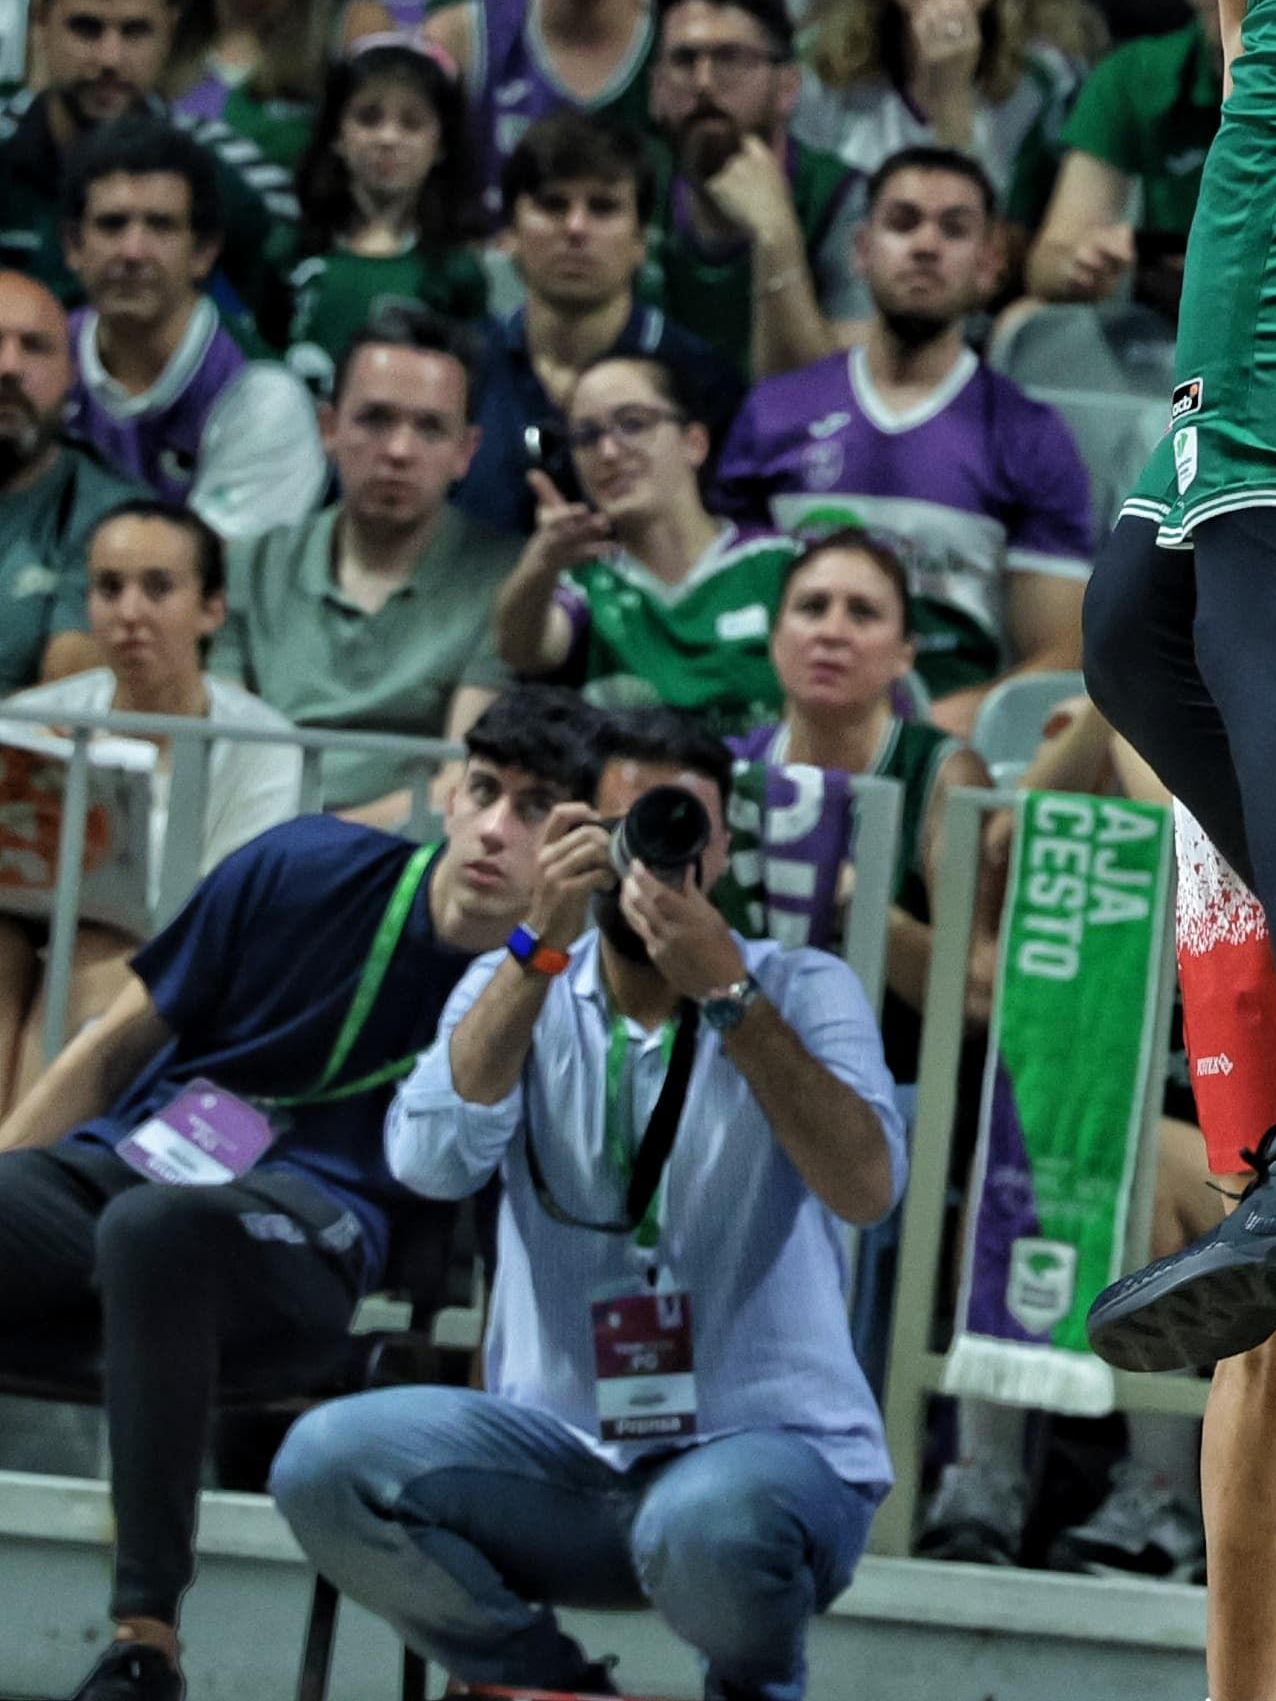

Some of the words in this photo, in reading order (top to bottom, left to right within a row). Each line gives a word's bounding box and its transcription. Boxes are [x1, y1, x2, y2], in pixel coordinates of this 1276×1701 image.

[1172, 395, 1192, 416] acb
[1017, 797, 1096, 981] CESTO
[1086, 803, 1158, 925] AJA
